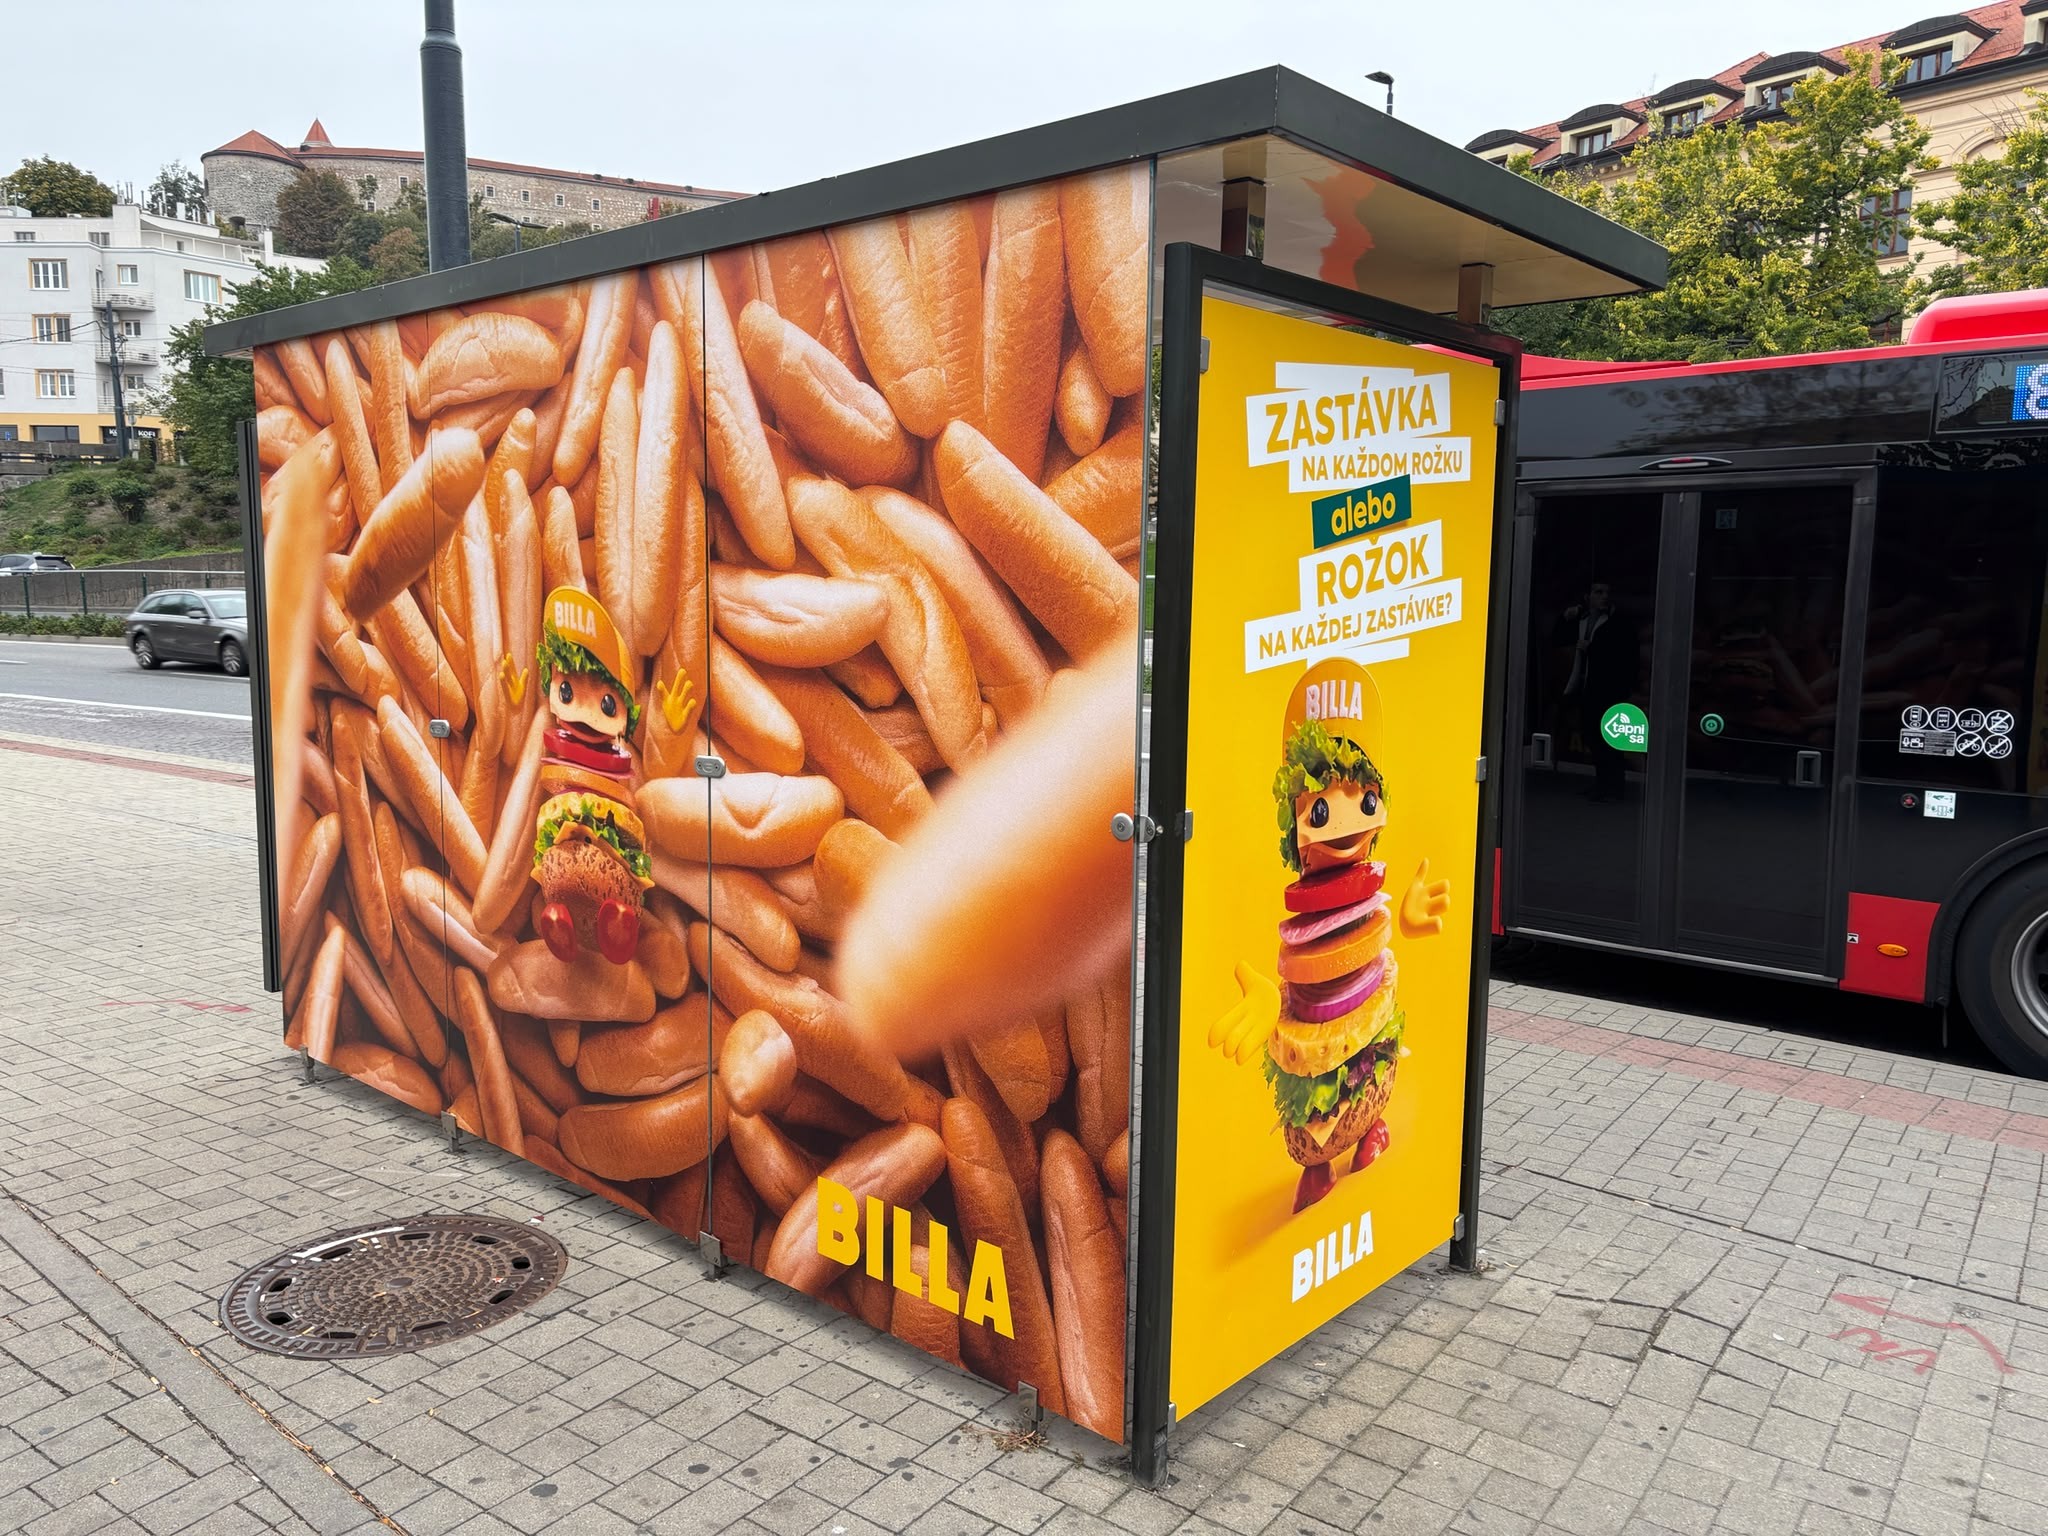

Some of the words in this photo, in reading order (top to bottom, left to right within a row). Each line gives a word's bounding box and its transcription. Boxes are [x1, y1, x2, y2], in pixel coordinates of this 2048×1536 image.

[1265, 376, 1438, 454] ZASTÁVKA
[1302, 455, 1329, 482] NA
[1333, 446, 1408, 480] KAŽDOM
[1411, 444, 1464, 476] ROŽKU
[1331, 489, 1397, 537] alebo
[1316, 533, 1430, 608] ROŽOK
[554, 601, 597, 638] BILLA
[1259, 630, 1287, 660] NA
[1291, 612, 1362, 653] KAŽDEJ
[1366, 591, 1453, 634] ZASTÁVKE?
[1305, 680, 1363, 721] BILLA
[1612, 721, 1645, 737] tapni
[1629, 734, 1645, 744] sa
[817, 1175, 1015, 1340] BILLA
[1292, 1210, 1374, 1304] BILLA
